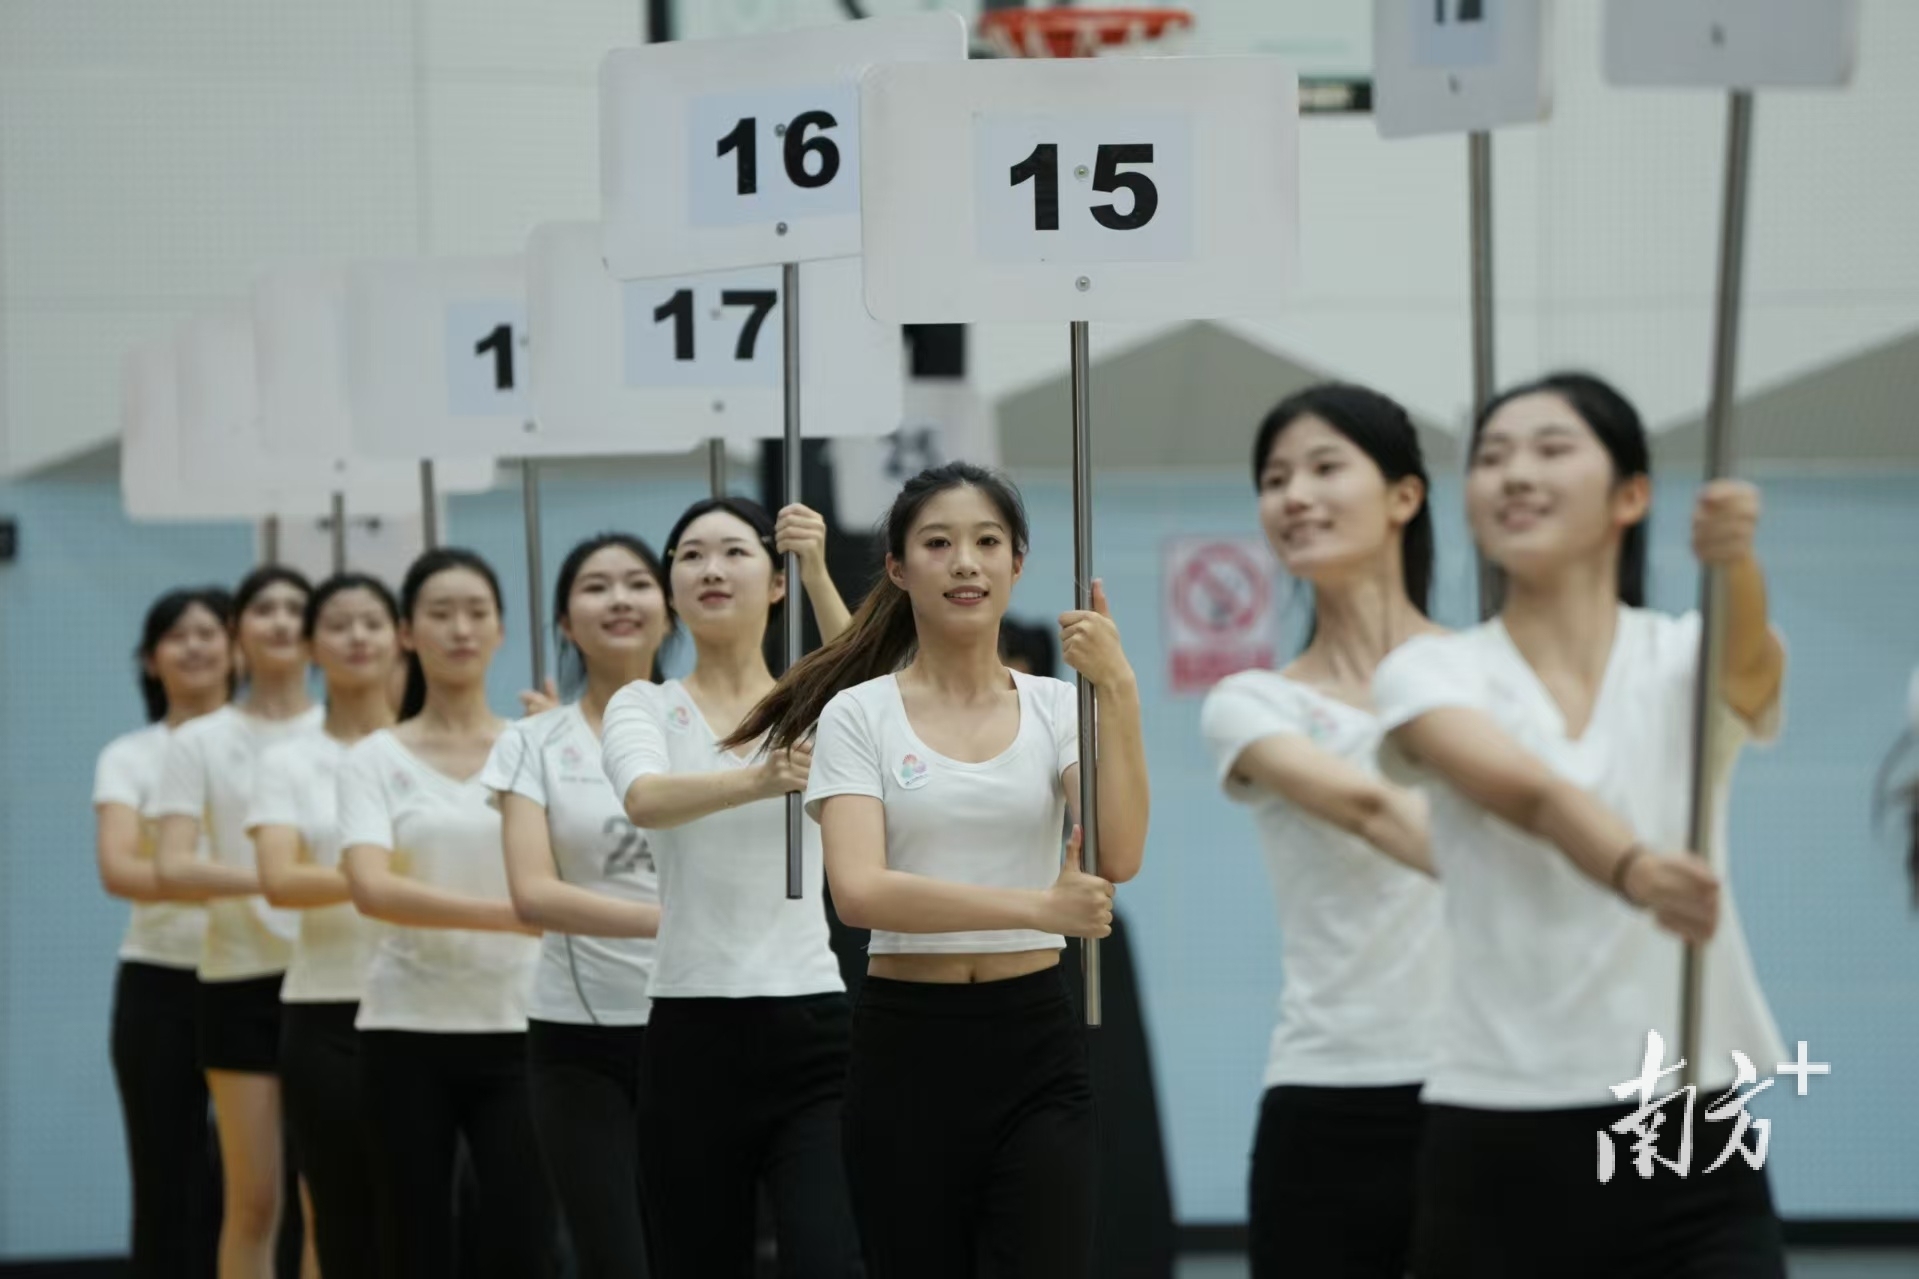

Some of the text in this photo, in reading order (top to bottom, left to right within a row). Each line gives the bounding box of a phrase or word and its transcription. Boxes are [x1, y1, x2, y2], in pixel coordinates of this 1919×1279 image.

[716, 110, 841, 196] 16
[1009, 143, 1159, 231] 15
[475, 324, 515, 390] 1
[653, 289, 778, 361] 17
